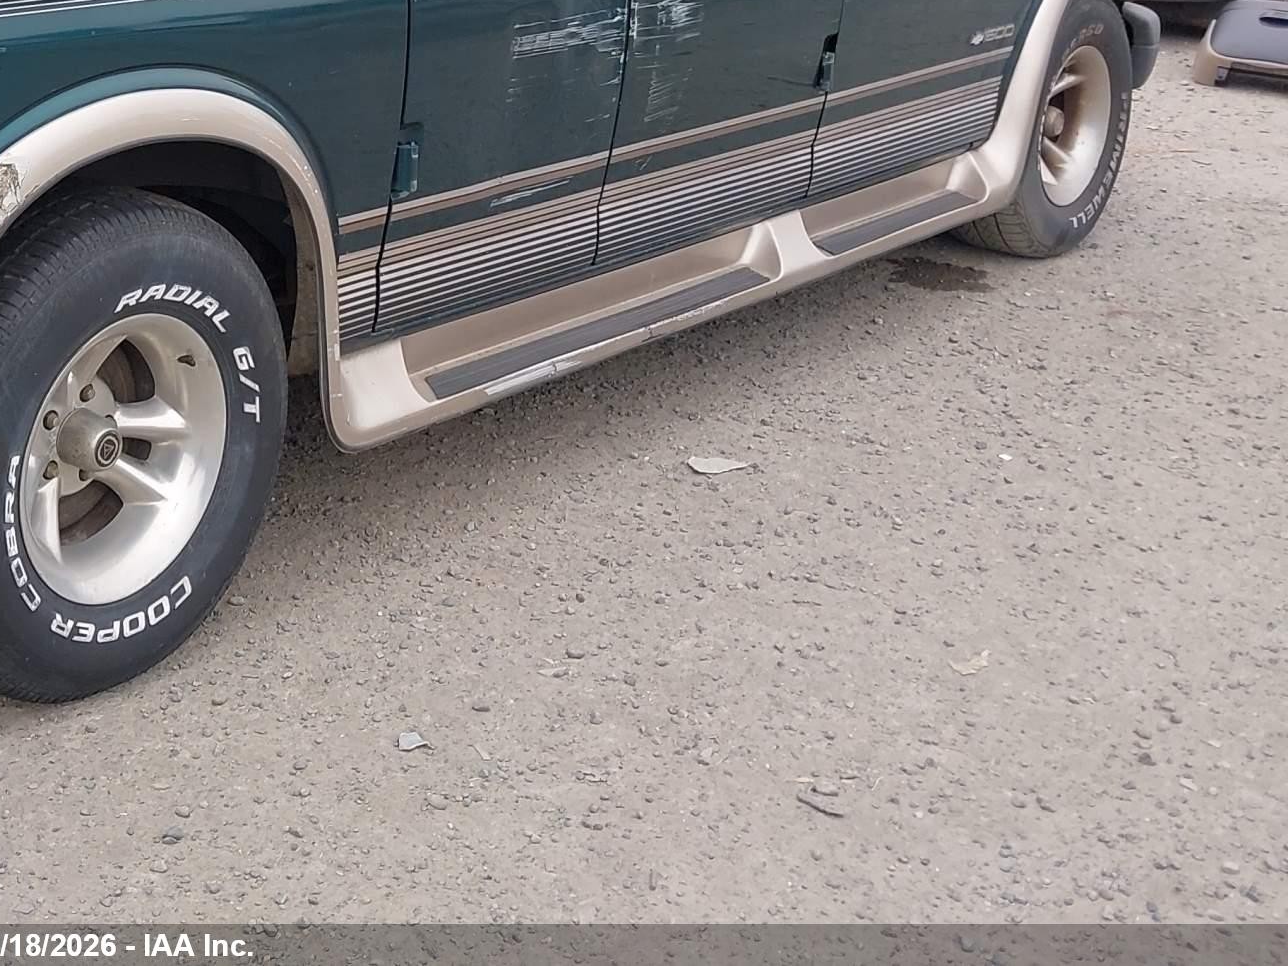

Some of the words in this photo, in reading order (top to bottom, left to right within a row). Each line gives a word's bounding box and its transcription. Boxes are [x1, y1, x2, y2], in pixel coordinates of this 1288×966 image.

[114, 282, 233, 334] RADIAL
[231, 345, 263, 423] G/T
[2, 454, 43, 612] COBRA
[50, 574, 194, 645] COOPER
